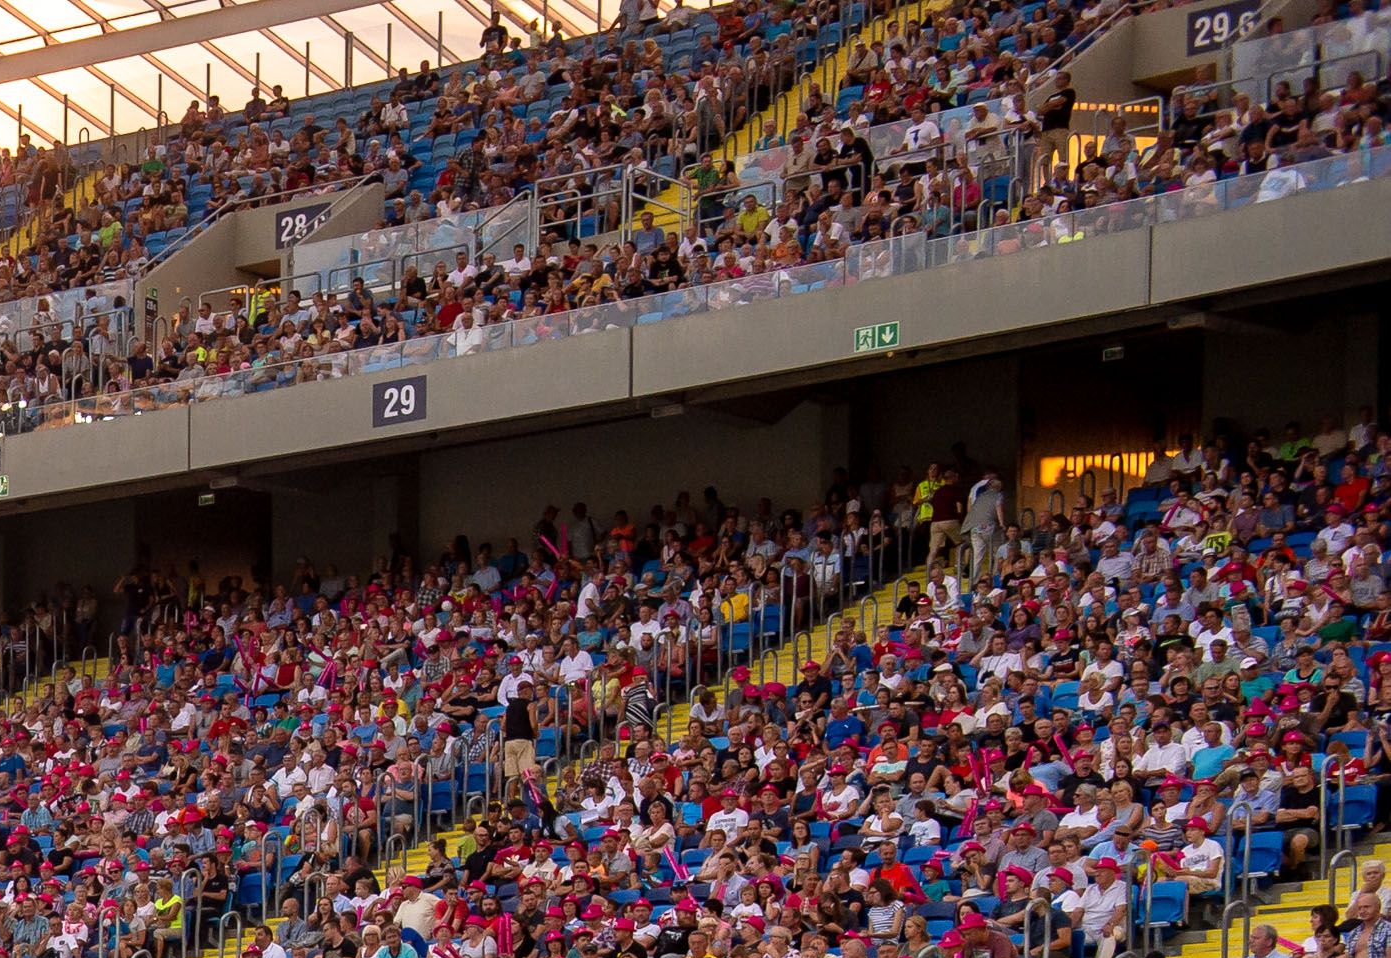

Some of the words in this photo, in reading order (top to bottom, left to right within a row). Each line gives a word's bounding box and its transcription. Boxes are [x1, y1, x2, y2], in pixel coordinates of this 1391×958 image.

[1194, 12, 1229, 47] 29
[281, 214, 308, 243] 28
[383, 385, 416, 418] 29
